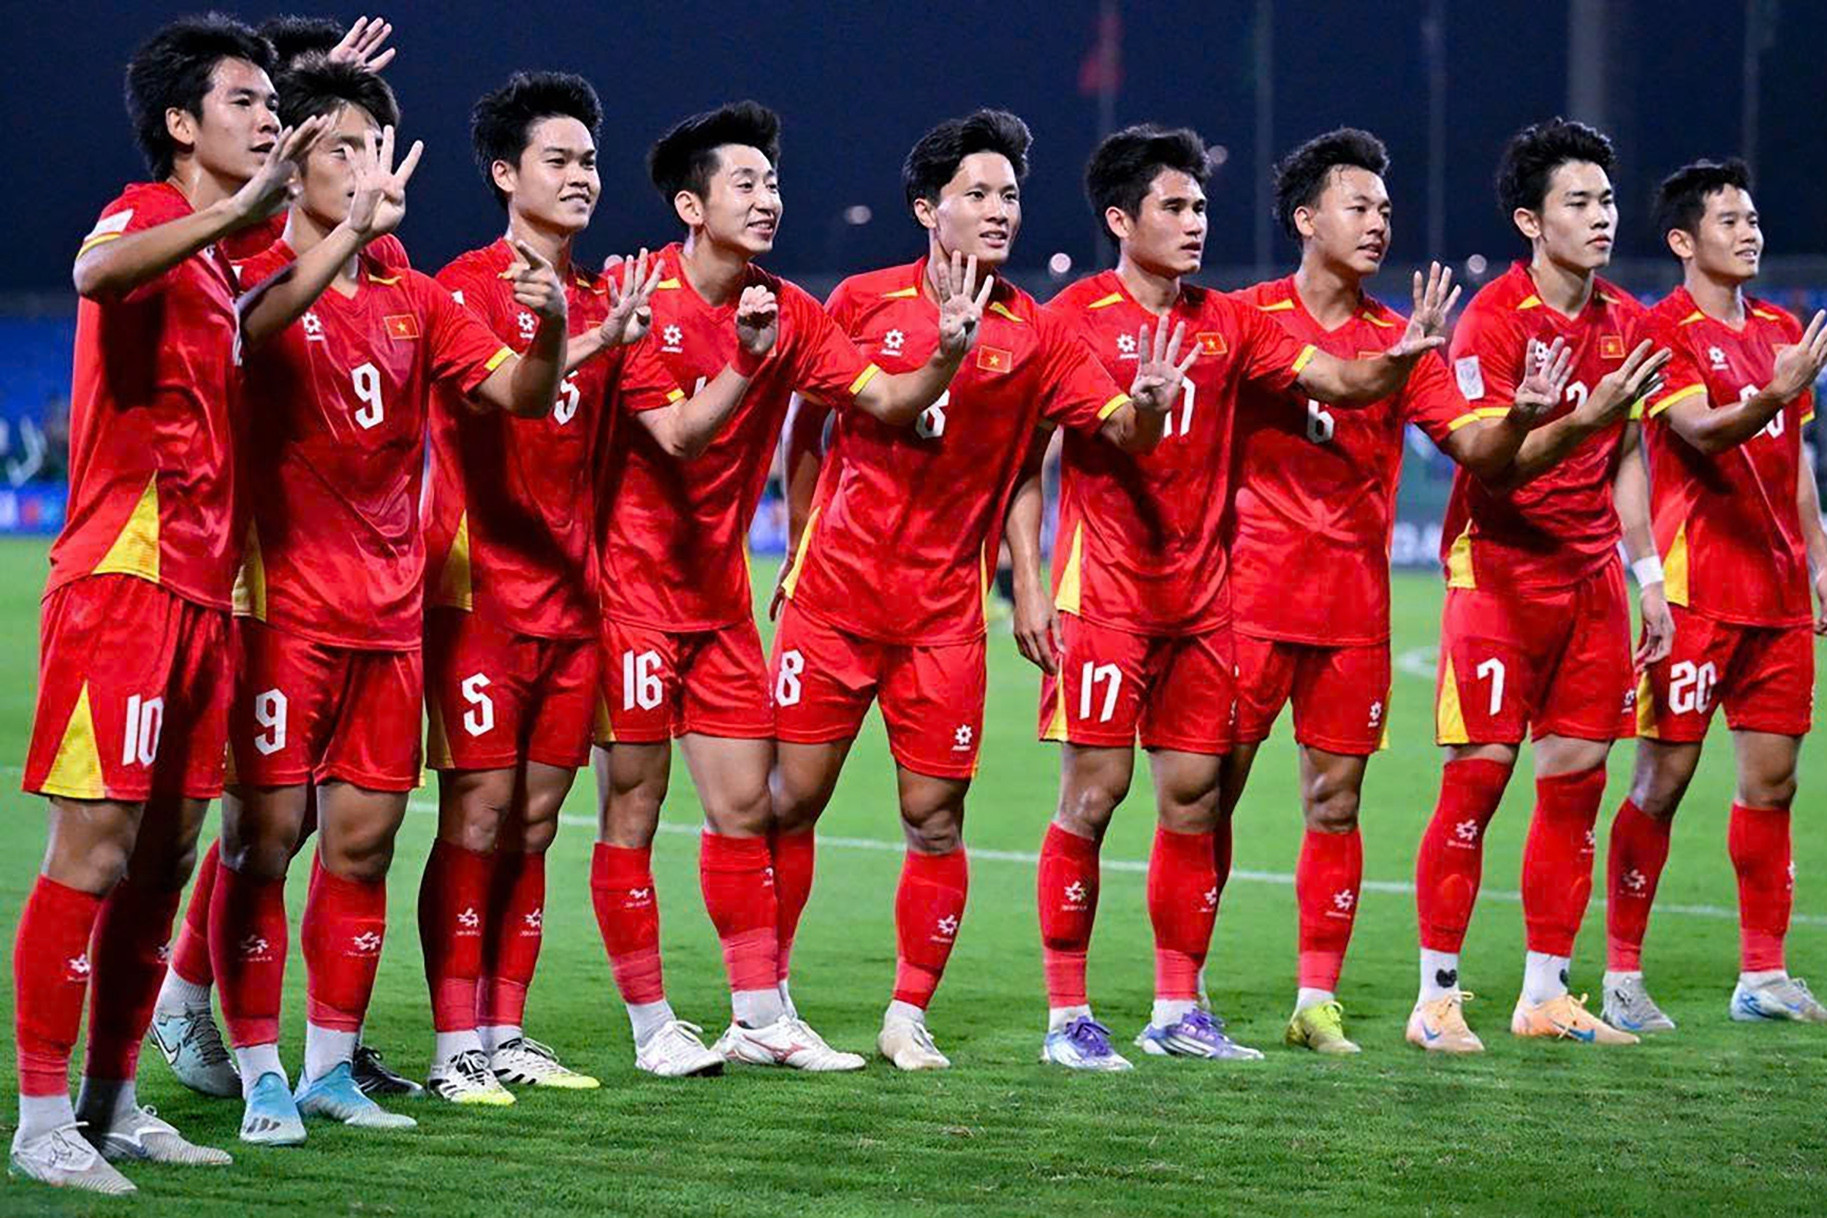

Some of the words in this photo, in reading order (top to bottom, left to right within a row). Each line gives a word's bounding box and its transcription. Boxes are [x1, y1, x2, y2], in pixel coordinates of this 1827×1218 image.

[351, 362, 384, 430] 9
[554, 370, 580, 425] 5
[461, 672, 494, 738] 5
[623, 649, 663, 711] 16
[775, 649, 805, 707] 8
[1079, 660, 1122, 723] 17
[1476, 657, 1506, 716] 7
[1668, 660, 1717, 715] 20
[122, 693, 164, 767] 10
[255, 688, 288, 756] 9
